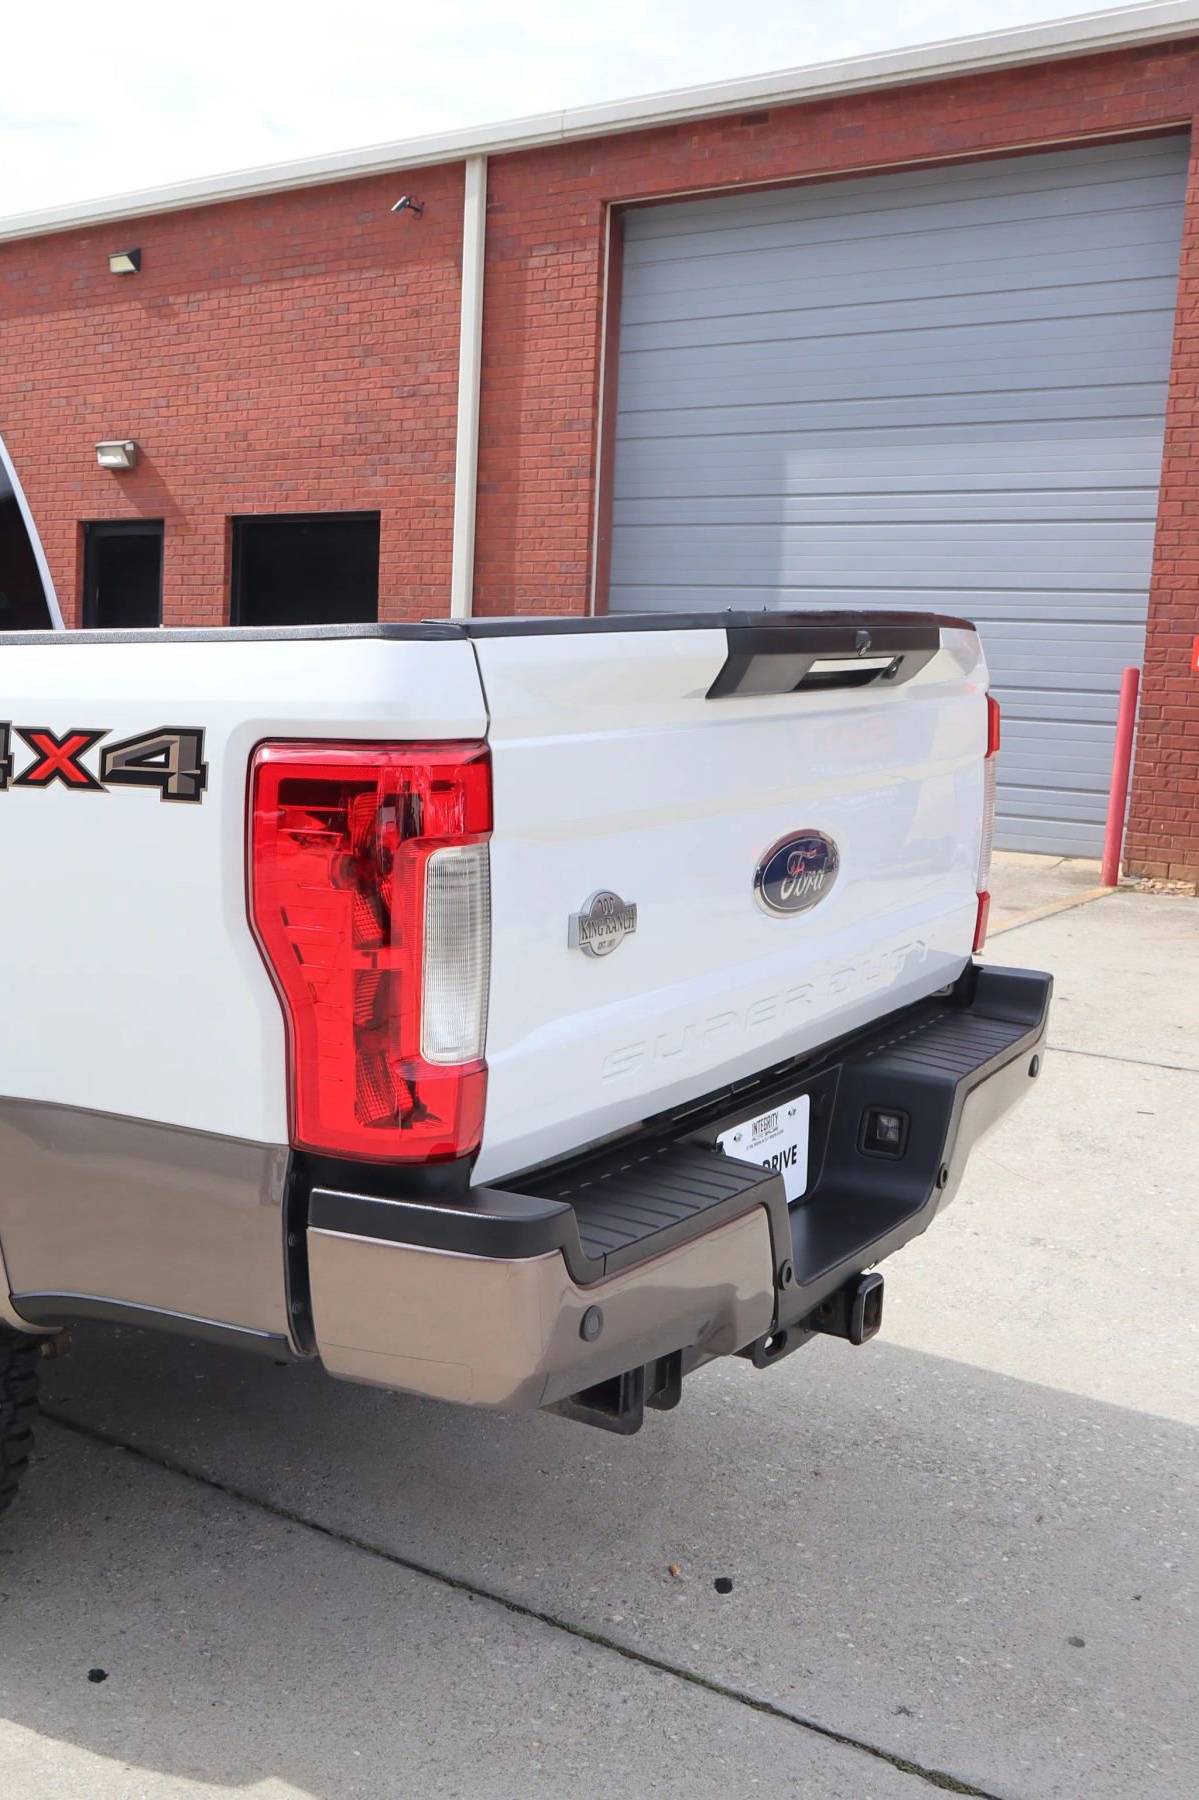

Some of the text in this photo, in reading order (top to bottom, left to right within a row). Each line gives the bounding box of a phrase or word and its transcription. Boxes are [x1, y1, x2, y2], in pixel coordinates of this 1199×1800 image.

[780, 848, 827, 901] Ford
[581, 908, 635, 941] KING RANCH
[601, 933, 935, 1082] SUPER DUTY
[751, 1111, 779, 1137] INTEGRITY
